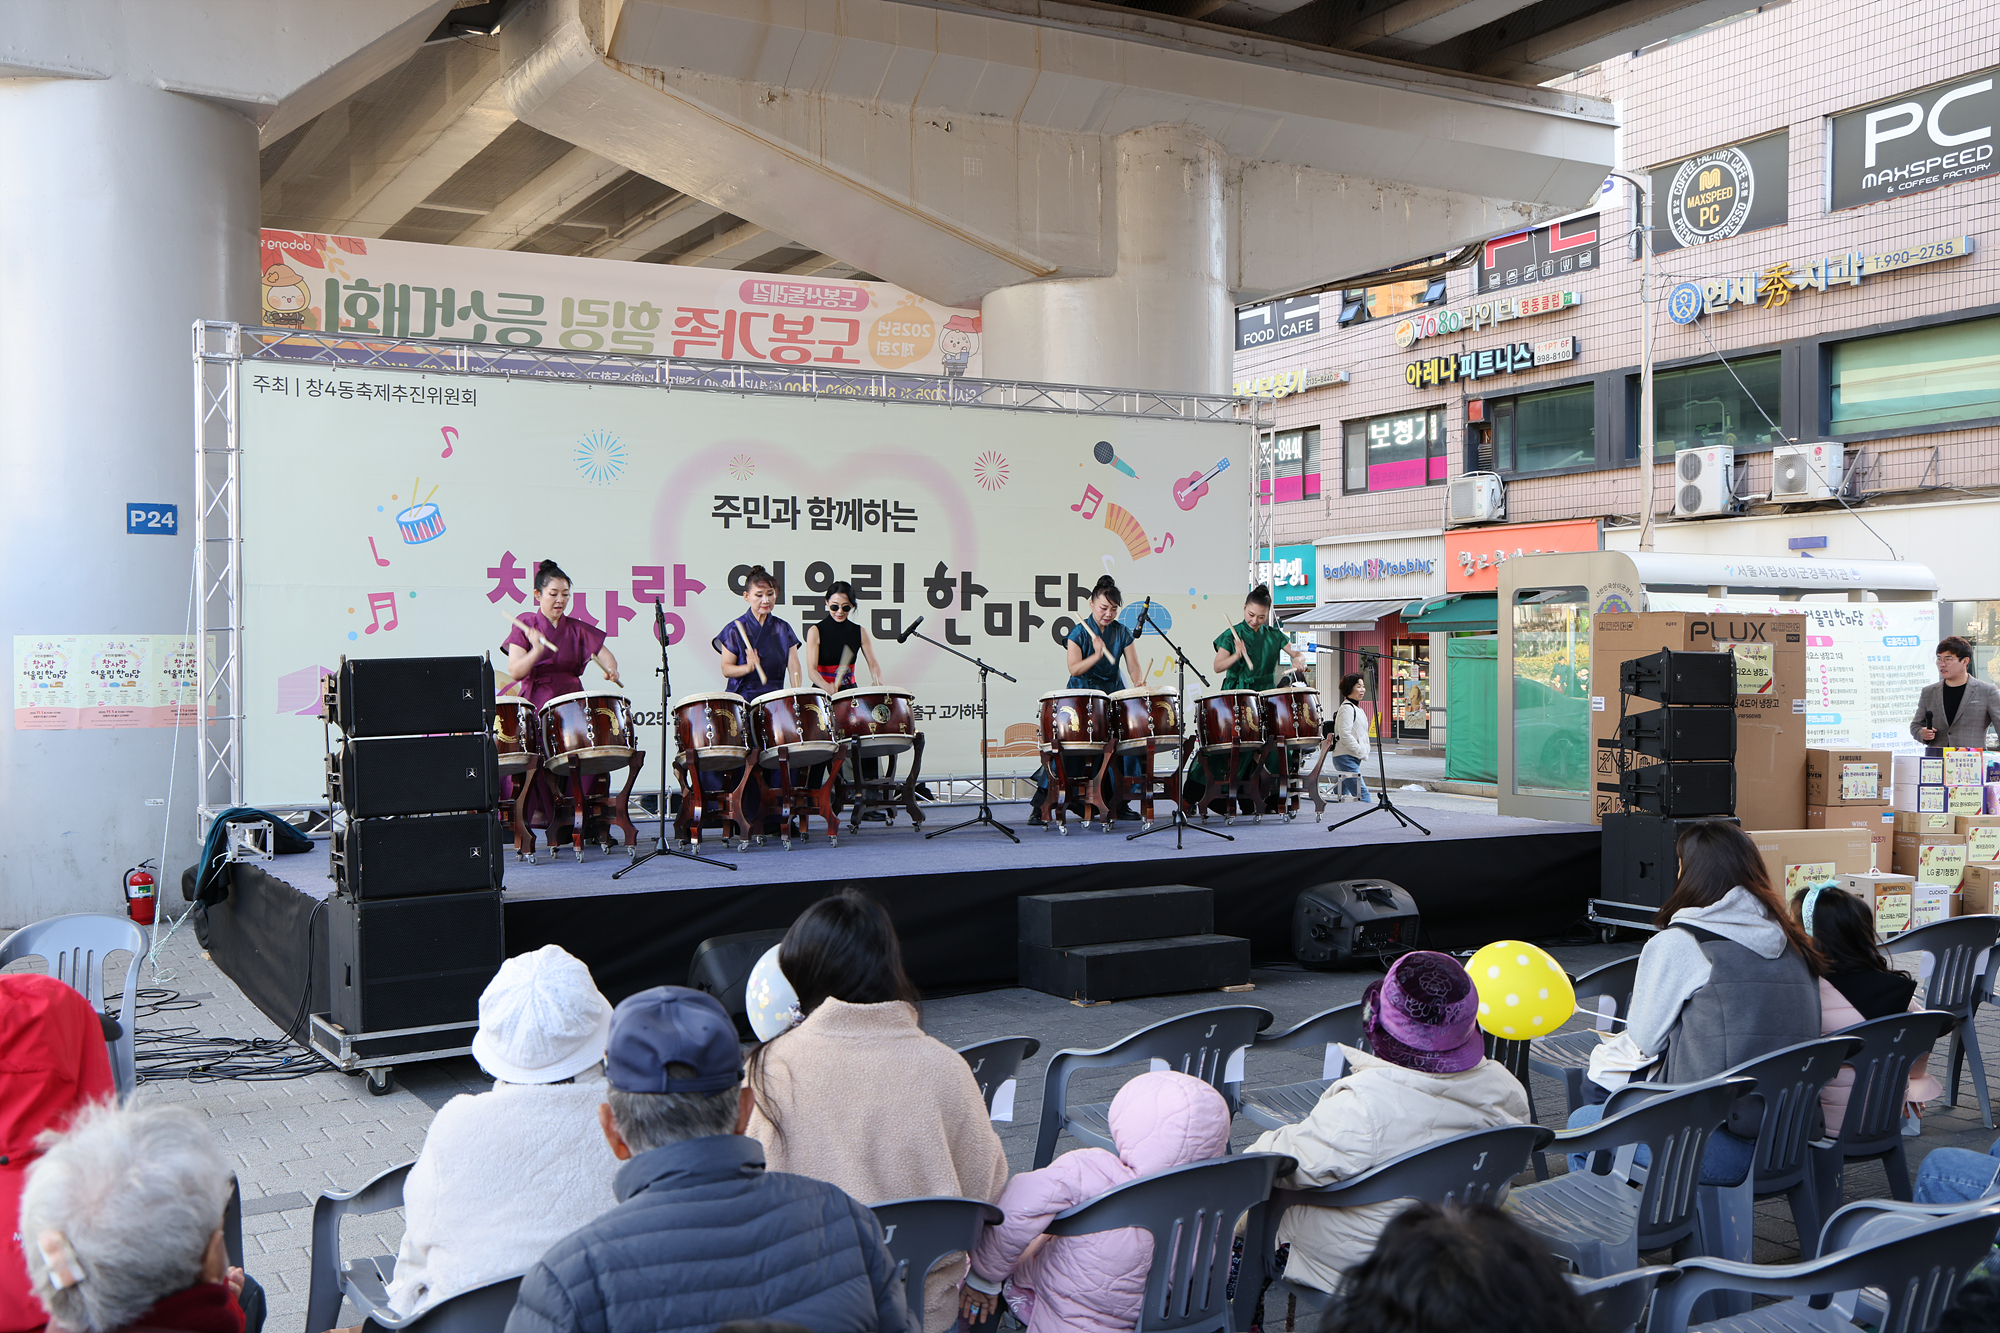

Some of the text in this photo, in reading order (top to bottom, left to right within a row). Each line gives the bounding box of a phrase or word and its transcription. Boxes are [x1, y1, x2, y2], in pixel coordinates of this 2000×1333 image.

[1864, 78, 1993, 169] PC
[1731, 156, 1748, 180] CAFE
[1862, 144, 1993, 190] MAXSPEED
[1898, 175, 1940, 191] COFFEE
[1943, 162, 1991, 180] FACTORY
[1687, 186, 1734, 209] MAXSPEED
[1699, 204, 1720, 227] PC
[1874, 242, 1954, 269] T.990-2755
[1243, 318, 1314, 346] FOOD CAFE
[1560, 339, 1570, 348] 6F
[1536, 350, 1571, 364] 998-8100
[252, 374, 478, 407] 주최 창4동축제추진위원회
[130, 510, 175, 528] P24
[711, 495, 919, 533] 주민과 함께하는
[1323, 561, 1362, 579] baskin
[1387, 557, 1435, 577] robbins
[1737, 564, 1850, 581] 서울시립상이군경복지관
[1690, 621, 1767, 643] PLUX
[1753, 668, 1769, 676] 냉장고
[1739, 699, 1780, 709] 4도어 냉장고
[1757, 844, 1779, 852] AMSUNG
[1935, 868, 1959, 877] 공기청정기
[1205, 1024, 1218, 1038] J
[1893, 1028, 1907, 1043] J
[972, 1058, 985, 1074] J
[1801, 1056, 1815, 1072] J
[1472, 1151, 1488, 1171] J
[883, 1224, 897, 1245] J
